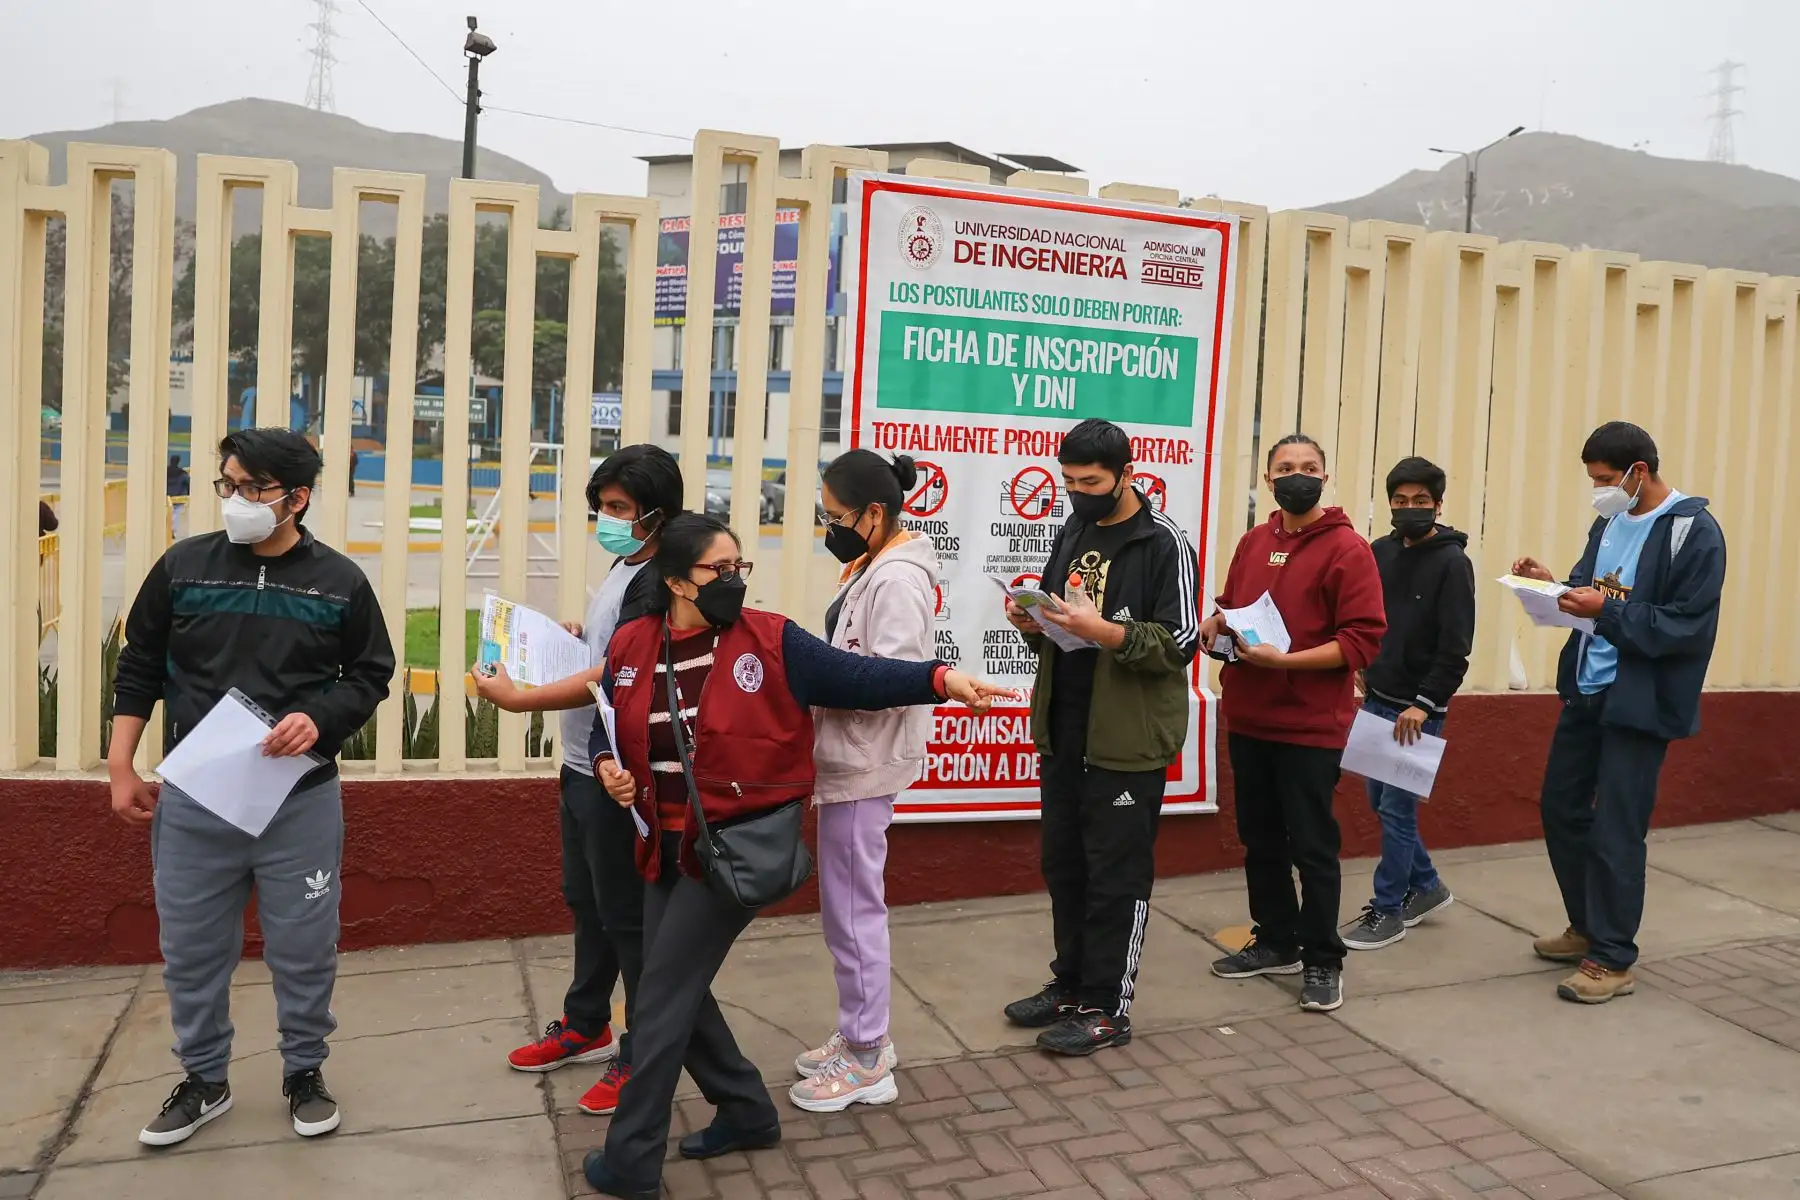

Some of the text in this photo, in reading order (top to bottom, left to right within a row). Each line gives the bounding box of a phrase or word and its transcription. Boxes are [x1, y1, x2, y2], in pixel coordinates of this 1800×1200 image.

[954, 221, 1126, 253] UNIVERSIDAD NACIONAL
[954, 240, 1128, 280] DE INGENIERÍA
[1150, 252, 1199, 264] OFICINA CENTRAL
[1191, 246, 1206, 257] UNI
[889, 281, 1184, 327] LOS POSTULANTES SOLO DEBEN PORTAR:
[903, 325, 1179, 380] FICHA DE INSCRIPCIÓN
[1011, 373, 1076, 410] Y DNI
[872, 421, 999, 454] TOTALMENTE
[1130, 436, 1194, 465] ORTAR:
[901, 520, 1065, 539] PARATOS CUALQUIER TIP
[1009, 538, 1022, 552] DE
[1023, 555, 1050, 564] BORRADO
[982, 630, 1021, 645] ARETES,
[982, 645, 1015, 660] RELOJ,
[986, 660, 1038, 675] LLAVEROS
[928, 715, 1034, 744] ECOMISA
[994, 752, 1010, 781] A
[1015, 752, 1041, 780] DE
[304, 886, 330, 900] adidas
